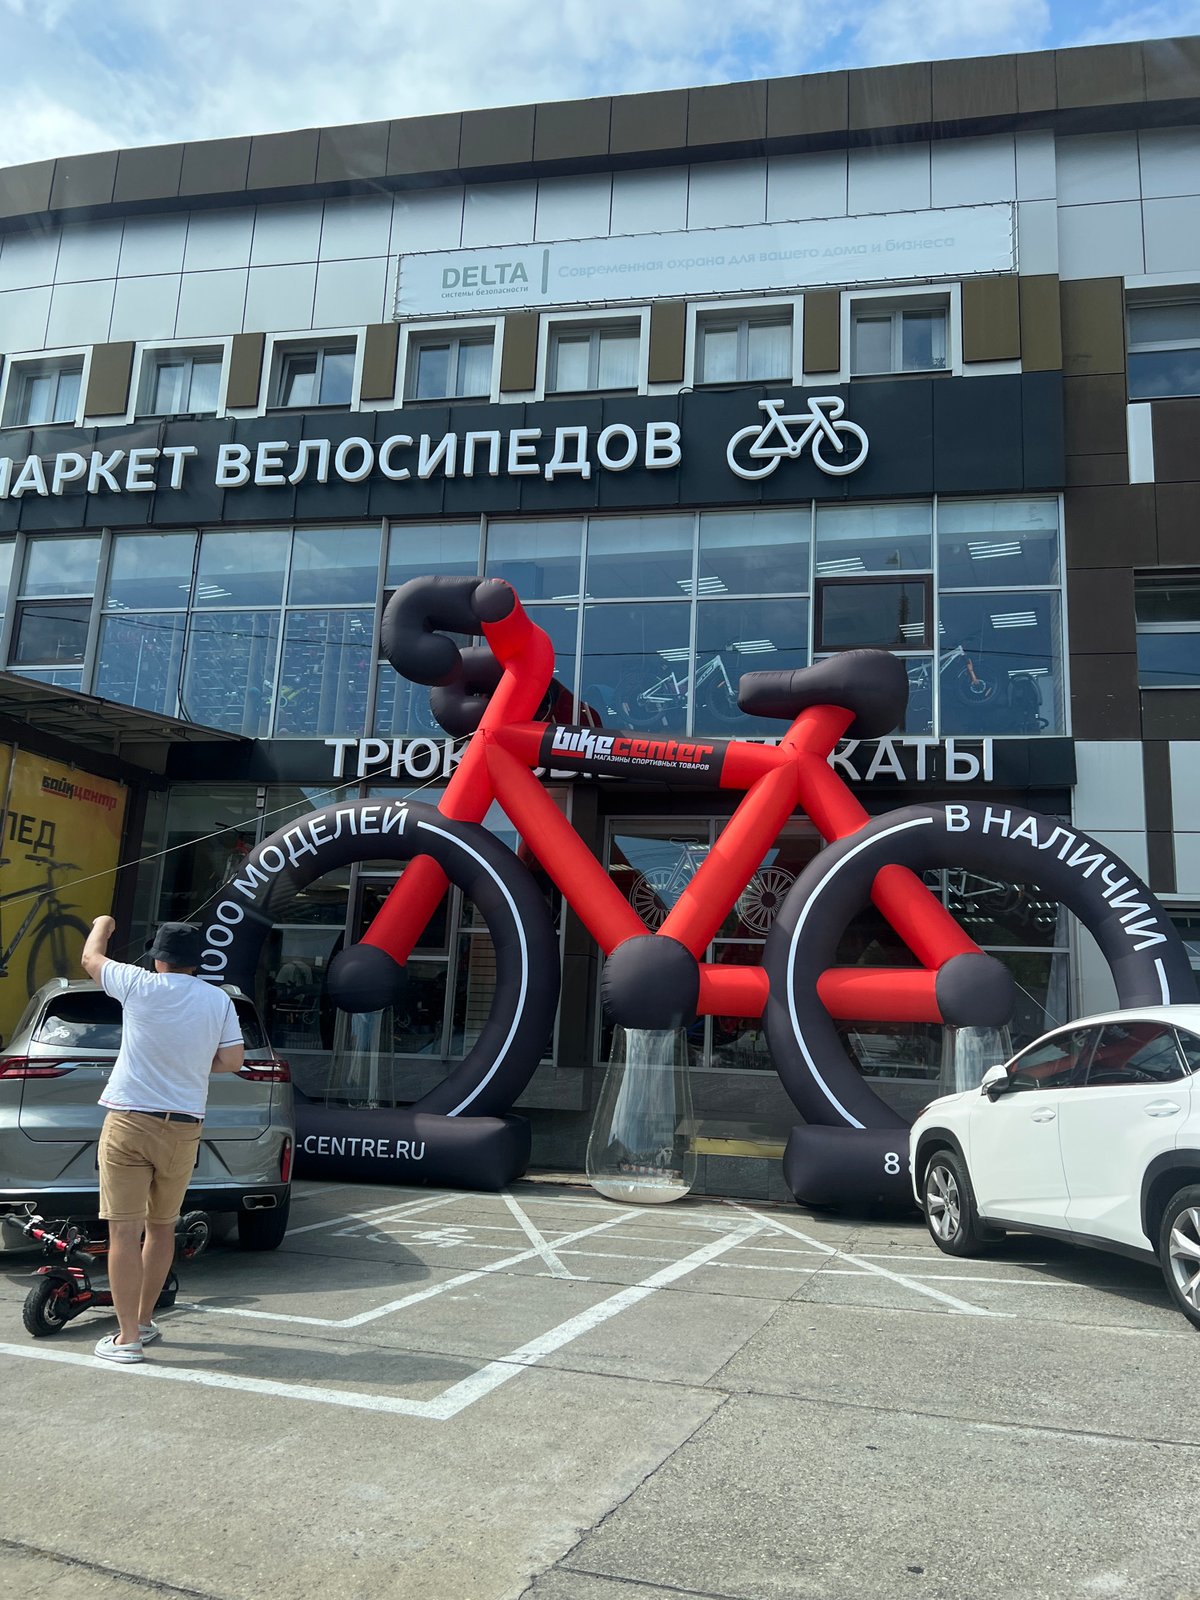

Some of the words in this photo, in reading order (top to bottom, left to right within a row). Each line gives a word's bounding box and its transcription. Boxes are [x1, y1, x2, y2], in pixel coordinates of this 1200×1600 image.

[558, 258, 663, 279] Современная
[667, 254, 725, 271] охрана
[728, 252, 756, 265] для
[759, 248, 820, 262] вашего
[822, 243, 867, 258] дома
[871, 242, 882, 253] и
[885, 236, 955, 252] бизнеса
[441, 262, 529, 289] DELTA
[441, 291, 474, 299] системы
[476, 285, 529, 296] безопасности
[0, 445, 198, 499] АРКЕТ
[215, 421, 682, 487] ВЕЛОСИПЕДОВ
[593, 753, 631, 763] МАГАЗИНЫ
[632, 757, 677, 768] СПОРТИВНЫХ
[678, 761, 710, 771] ТОВАРОВ
[232, 801, 409, 900] МОДЕЛЕЙ
[944, 804, 971, 832] В
[981, 806, 1168, 952] НАЛИЧИИ
[884, 1152, 900, 1175] 8
